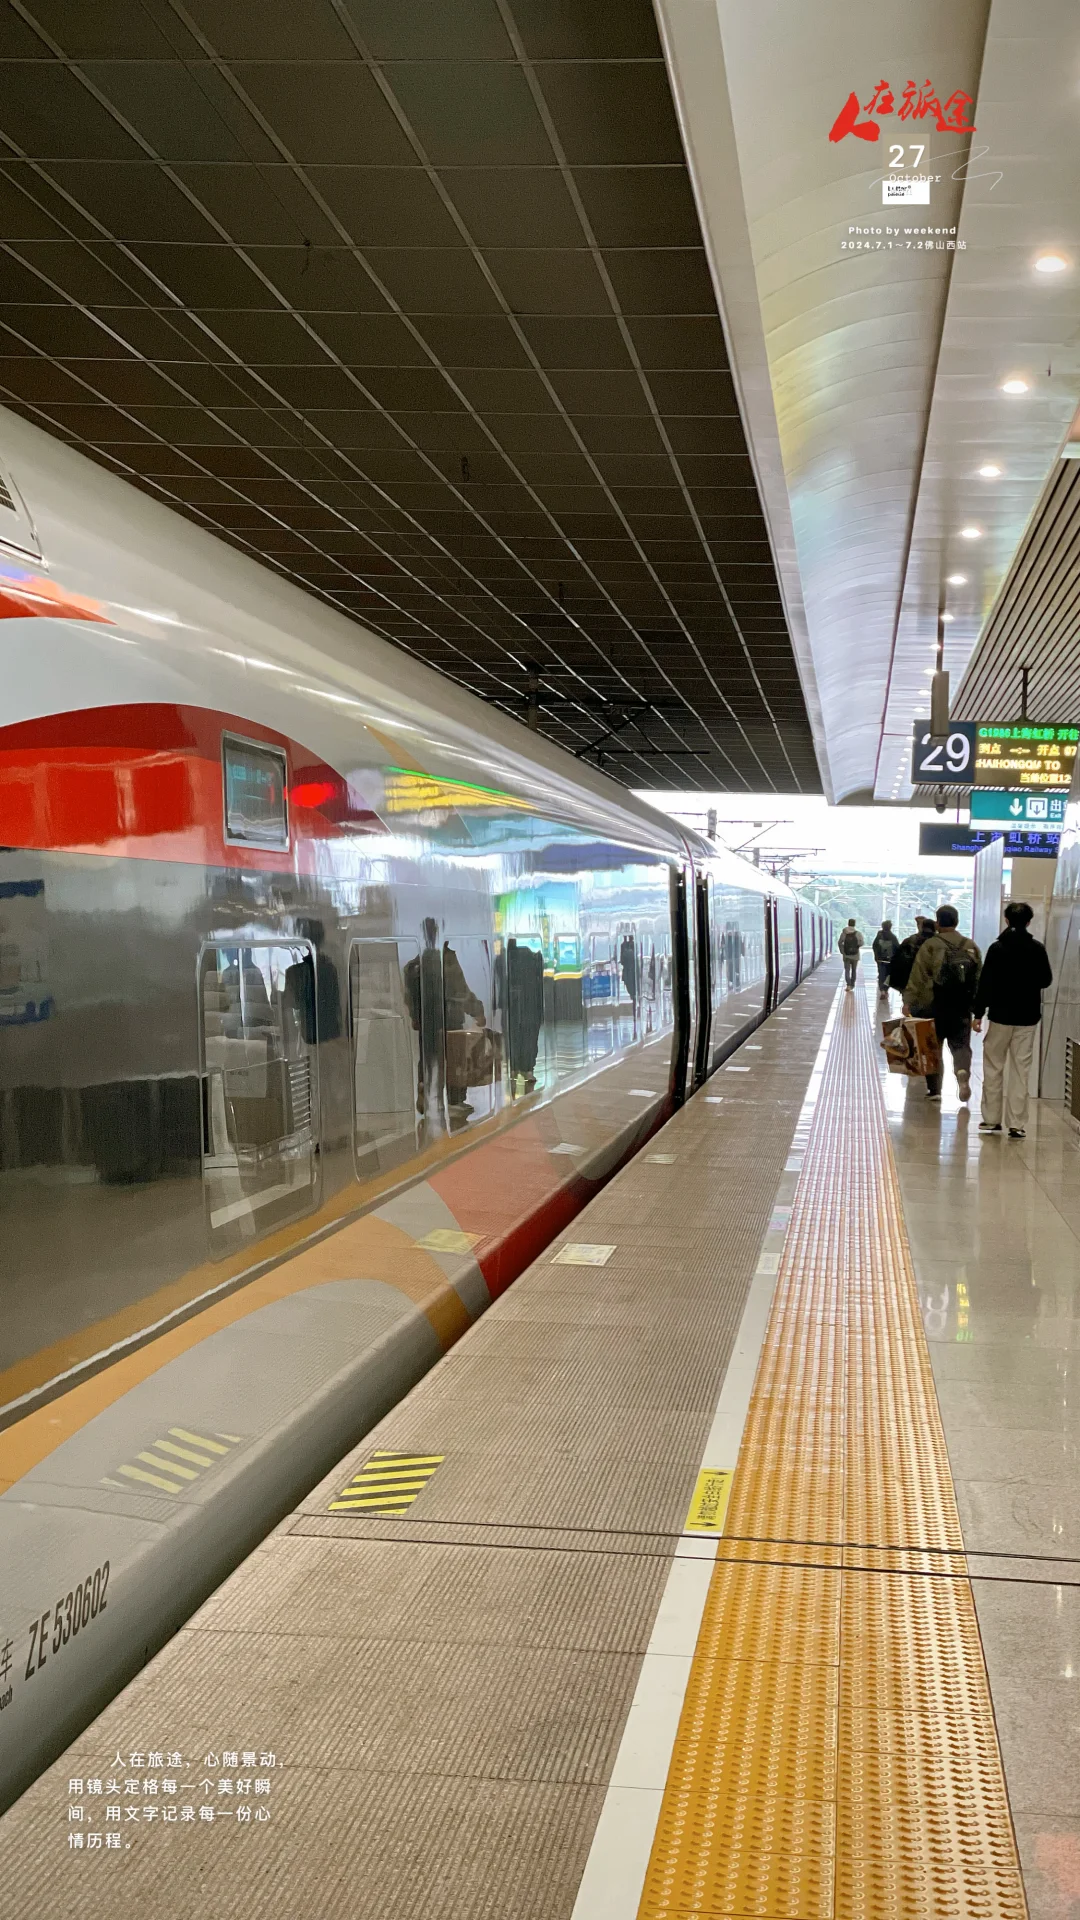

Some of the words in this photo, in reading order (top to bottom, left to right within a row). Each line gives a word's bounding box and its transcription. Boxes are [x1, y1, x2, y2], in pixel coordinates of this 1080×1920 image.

[919, 732, 970, 772] 29
[951, 844, 982, 853] Shangha
[1024, 845, 1052, 854] Railway
